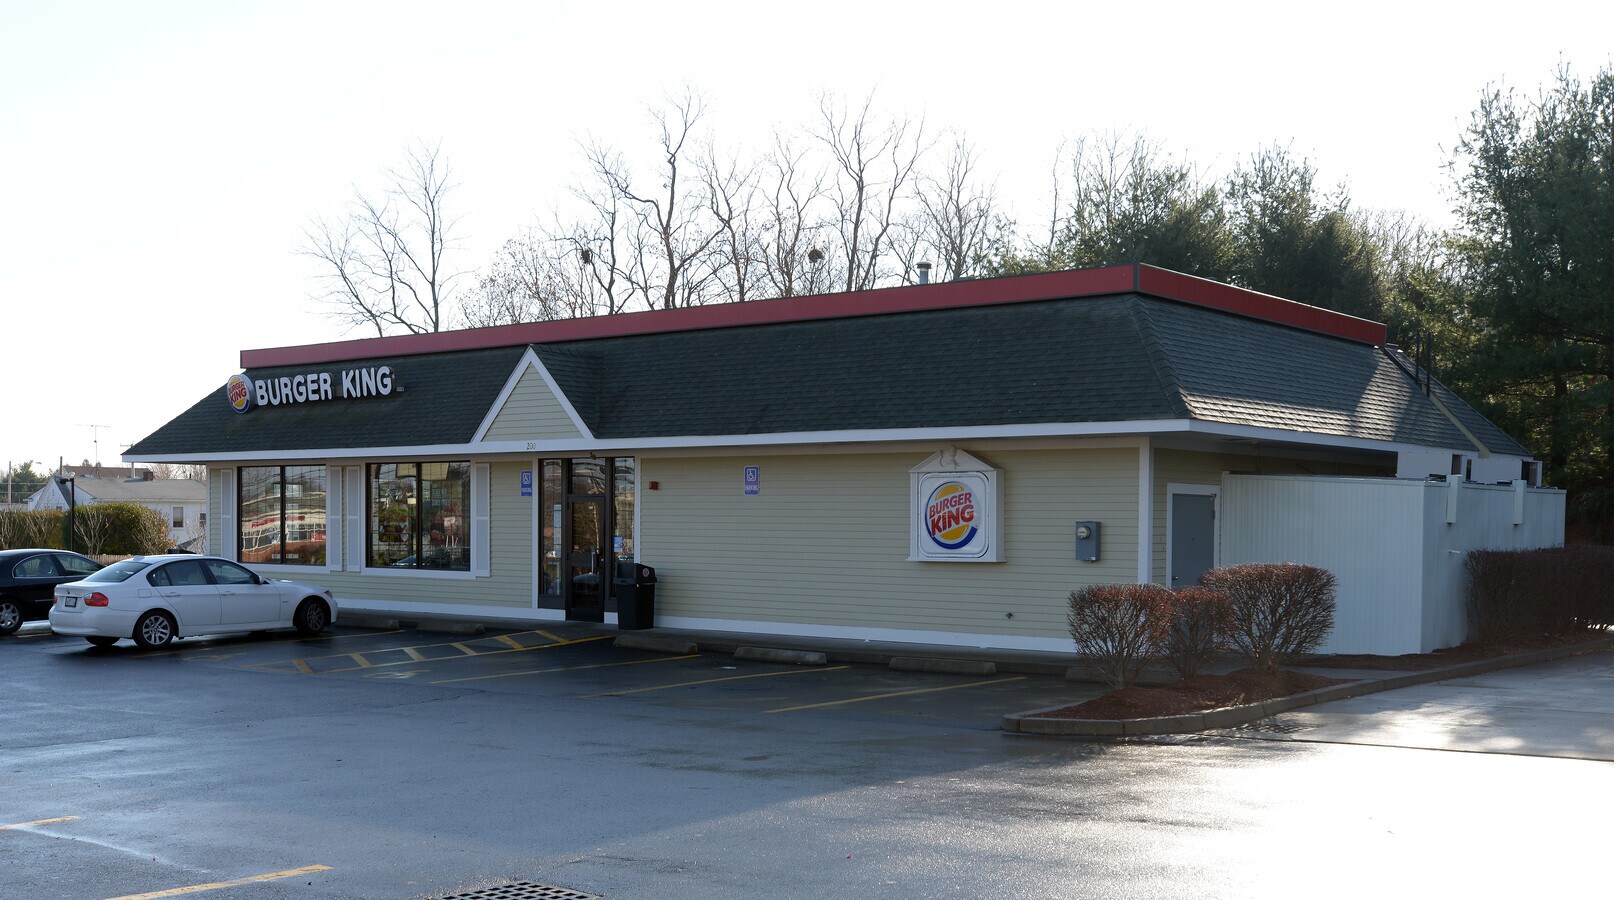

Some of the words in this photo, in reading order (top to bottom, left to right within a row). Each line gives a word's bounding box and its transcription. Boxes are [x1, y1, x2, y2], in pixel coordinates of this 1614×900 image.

[229, 380, 245, 394] BURGER
[230, 388, 247, 403] KING
[255, 373, 332, 406] BURGER
[341, 366, 391, 398] KING
[526, 442, 536, 450] 200
[929, 492, 972, 519] BURGER
[931, 505, 974, 536] KING
